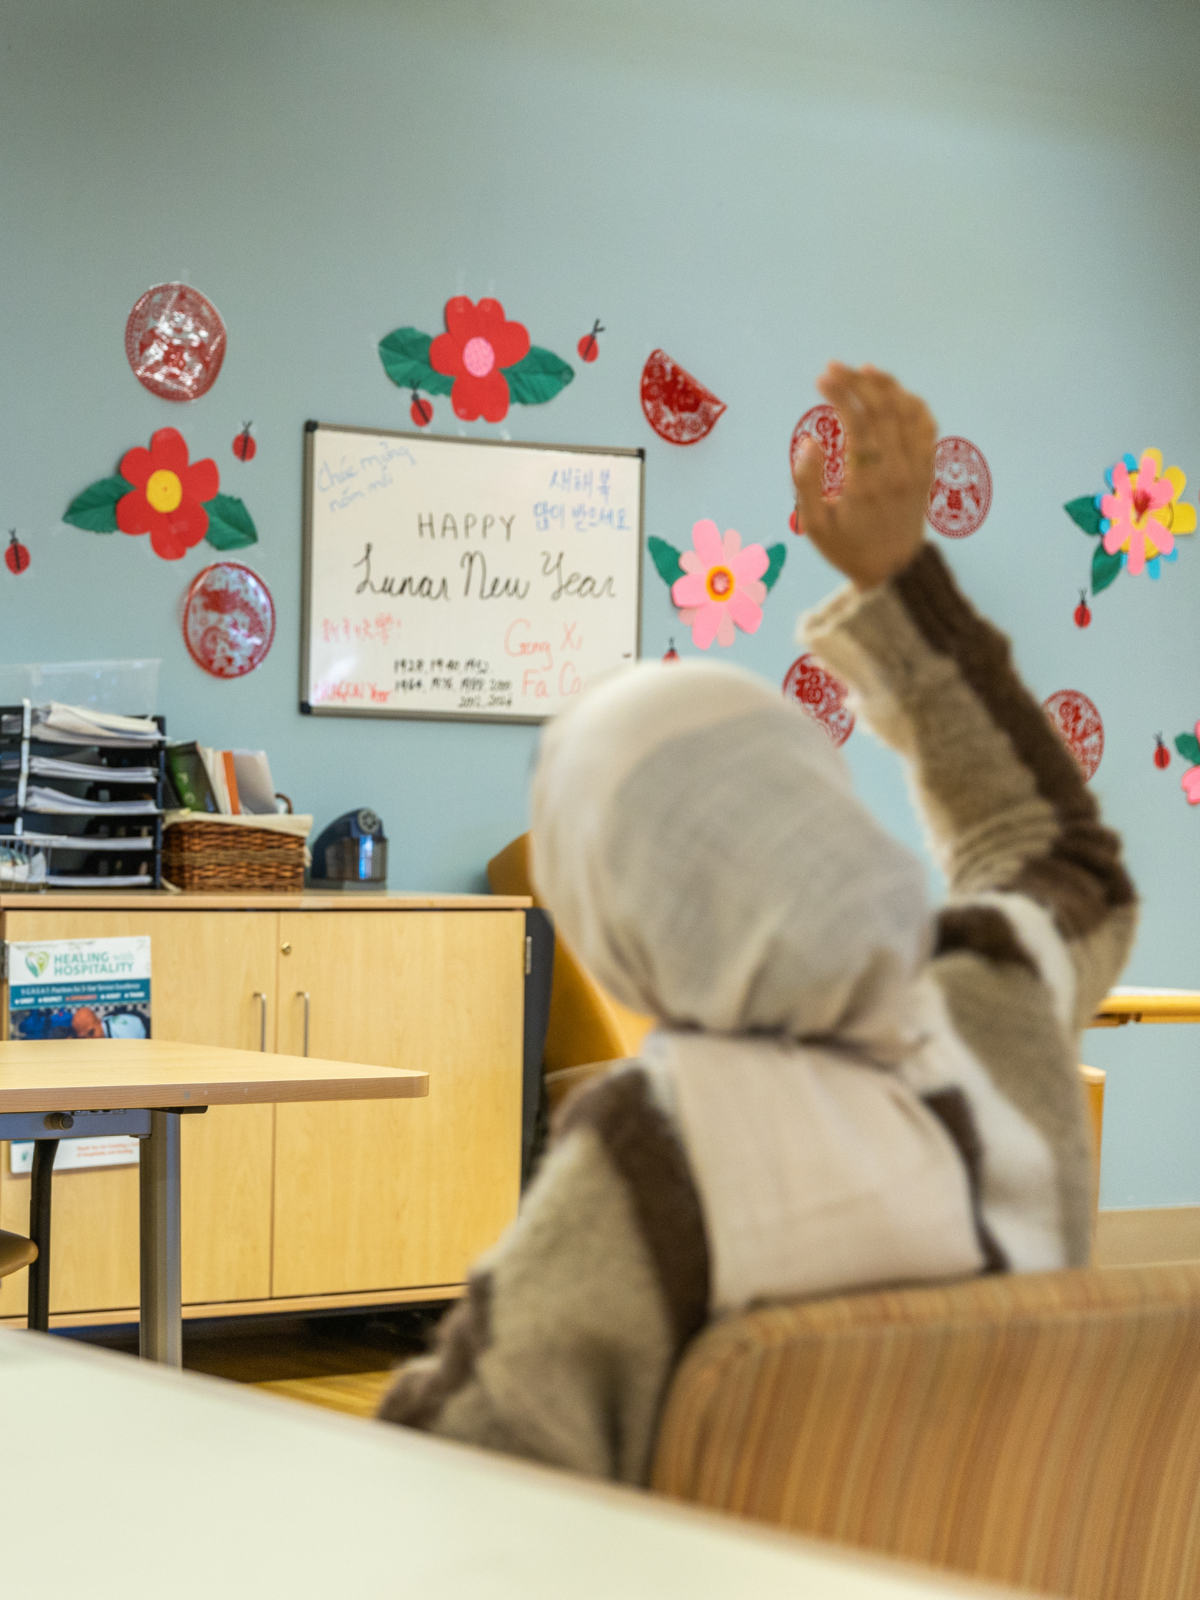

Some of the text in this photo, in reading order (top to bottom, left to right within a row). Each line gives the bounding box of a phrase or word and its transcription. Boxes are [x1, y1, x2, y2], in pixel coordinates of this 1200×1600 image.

[417, 512, 515, 541] HAPPY
[353, 542, 617, 600] Lunar New Year
[522, 668, 551, 699] Fa
[54, 952, 110, 964] HEALING
[54, 962, 135, 976] HOSPITALITY
